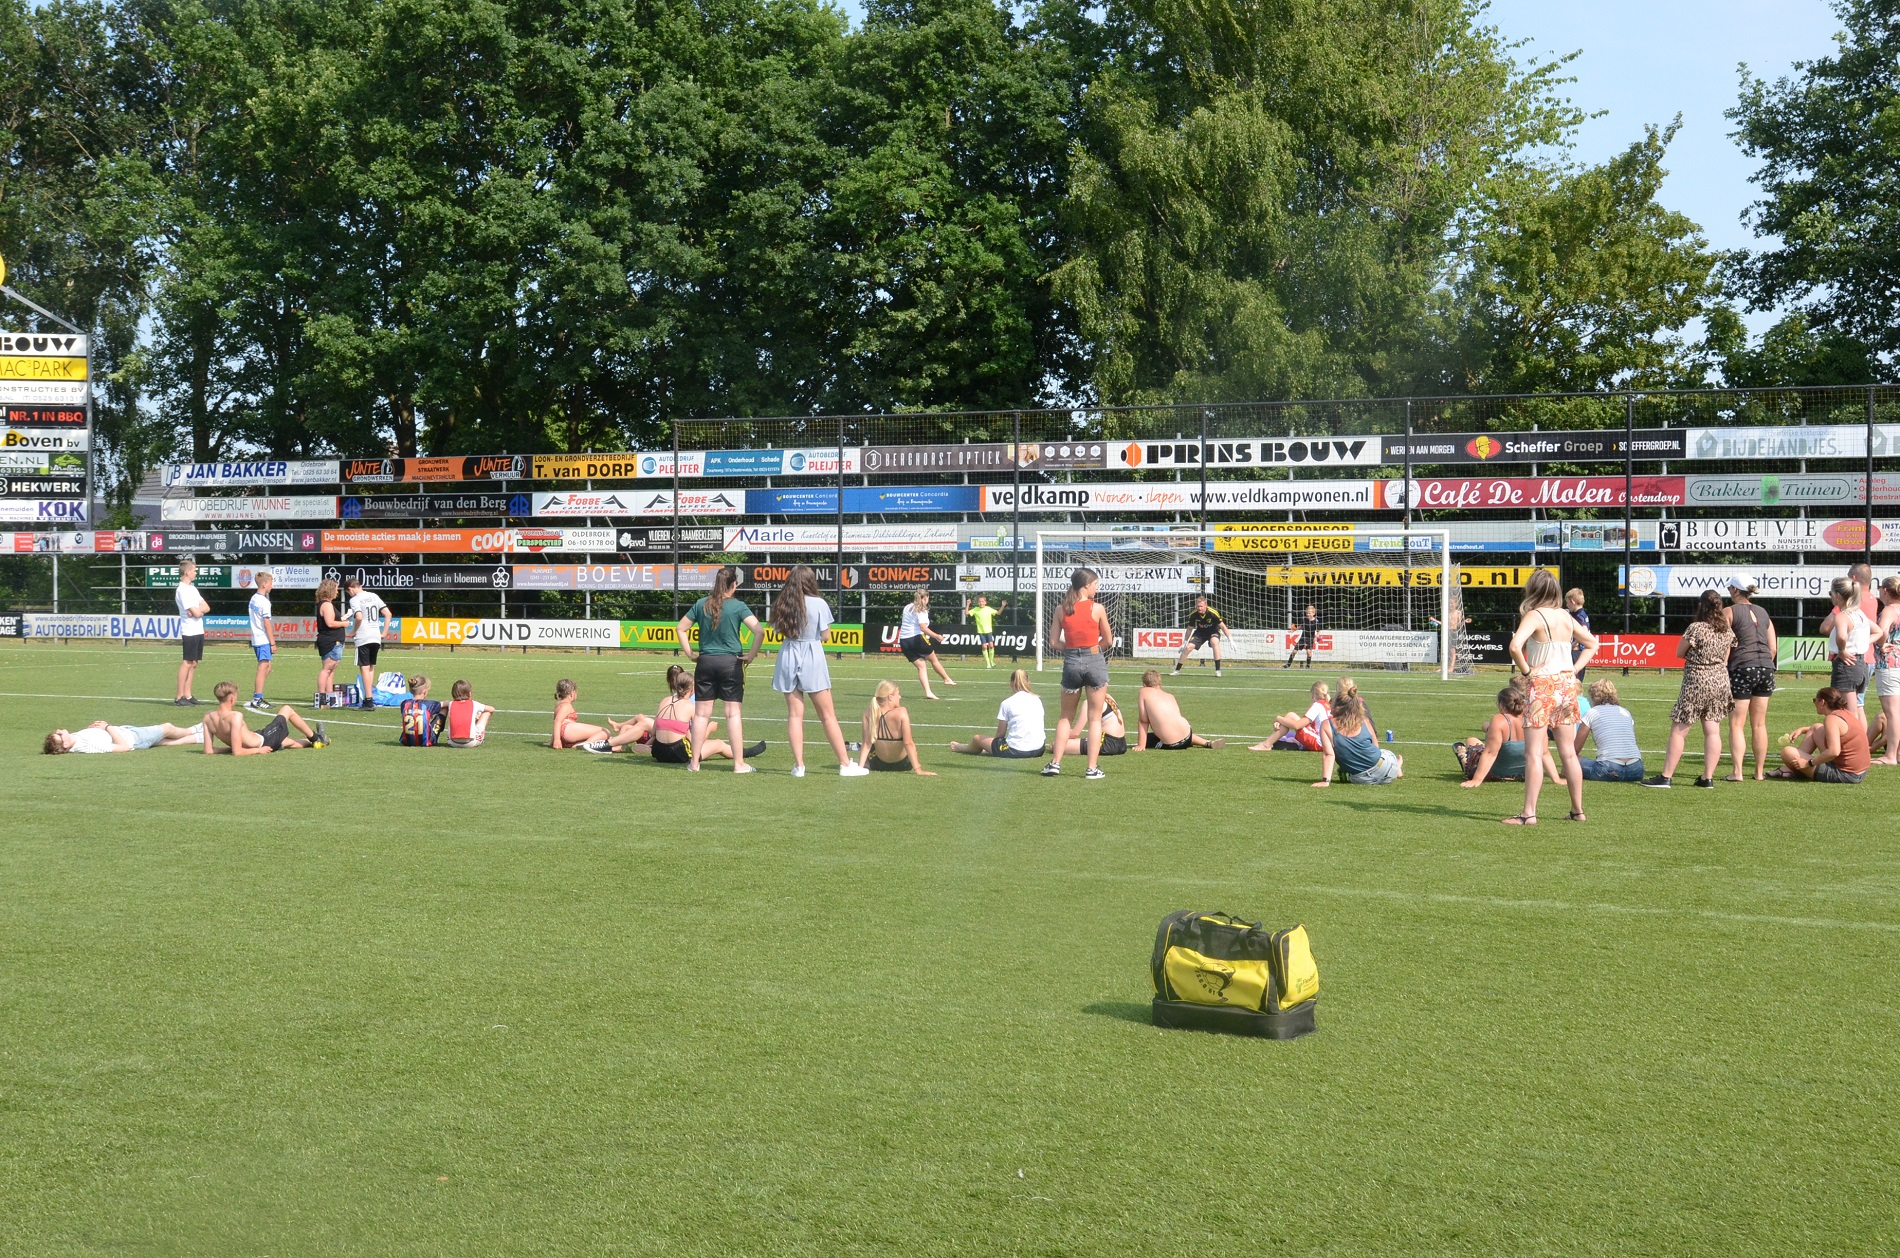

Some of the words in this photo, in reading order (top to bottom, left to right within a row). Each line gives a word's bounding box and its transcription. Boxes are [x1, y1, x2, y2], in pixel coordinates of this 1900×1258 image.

[9, 410, 31, 421] NR.
[32, 411, 39, 421] 1
[42, 411, 55, 422] IN
[57, 411, 84, 422] BBQ
[6, 434, 63, 448] Boven
[67, 438, 80, 448] bv
[1505, 441, 1561, 453] Scheffer
[1564, 440, 1604, 453] Groep
[1619, 440, 1681, 451] SCEFFERGROEP.NL
[1147, 443, 1252, 464] PRINS
[1261, 440, 1367, 462] BOUW
[1416, 445, 1429, 454] AAN
[1429, 445, 1455, 454] MORGEN
[728, 456, 755, 464] Onderhoud
[761, 455, 780, 463] Schade
[885, 451, 952, 467] BERGHORST
[958, 450, 1001, 465] OPTIEK
[186, 463, 218, 479] JAN
[221, 461, 287, 478] BAKKER
[490, 471, 521, 479] VERHUUR
[535, 465, 548, 478] T.
[553, 467, 581, 478] van
[587, 464, 635, 477] DORP
[11, 482, 81, 493] HEKWERK
[1424, 481, 1482, 508] Café
[1487, 480, 1523, 504] De
[1531, 479, 1613, 504] Molen
[1618, 491, 1680, 505] Ostendorp
[1696, 483, 1760, 497] Bakker
[1782, 482, 1844, 496] Tuinen
[567, 494, 601, 506] FOBBE
[992, 486, 1090, 506] vedkamp
[1145, 487, 1185, 510] slapen
[1190, 487, 1369, 506] www.veldkampwonen.nl
[179, 498, 248, 512] AUTOBEDRIJF
[251, 498, 291, 511] WIJNNE
[302, 499, 329, 507] specialist
[364, 498, 431, 512] Bouwbedrijf
[434, 500, 453, 509] van
[456, 498, 477, 509] den
[480, 496, 507, 511] Berg
[38, 501, 85, 521] KOK
[300, 509, 317, 517] jonge
[238, 533, 294, 550] JANSSEN
[302, 535, 314, 548] da
[324, 532, 335, 541] De
[337, 533, 369, 541] mooiste
[371, 532, 396, 541] acties
[398, 532, 421, 541] maak
[422, 532, 431, 543] je
[433, 533, 462, 541] samen
[471, 529, 514, 551] coop
[648, 530, 671, 541] VLOEREN
[681, 529, 723, 541] RAAMBEKLEDING
[739, 528, 794, 542] Marle
[151, 537, 163, 548] da
[628, 538, 647, 549] javol
[1303, 538, 1351, 549] JEUGD
[1371, 539, 1430, 549] TrendouT
[1686, 540, 1767, 550] accountants
[270, 567, 280, 575] Ter
[282, 567, 310, 575] Weele
[355, 567, 414, 587] Orchidee
[422, 573, 442, 583] thuis
[444, 573, 452, 583] in
[453, 573, 488, 584] bloemen
[577, 566, 654, 583] BOEVE
[869, 567, 952, 582] CONWES.NL
[1042, 567, 1119, 579] MECNIC
[1125, 567, 1183, 580] GERWIN
[869, 582, 888, 590] tools
[366, 605, 379, 624] 10
[205, 618, 249, 626] ServicePartner
[274, 621, 299, 632] van
[35, 624, 108, 637] AUTOBEDRIJF
[412, 620, 532, 641] ALLROUND
[538, 627, 611, 639] ZONWERING
[647, 628, 674, 641] van
[940, 631, 1027, 651] zonwring
[1138, 632, 1183, 648] KGS
[1285, 634, 1333, 650] KS
[403, 714, 424, 735] 21
